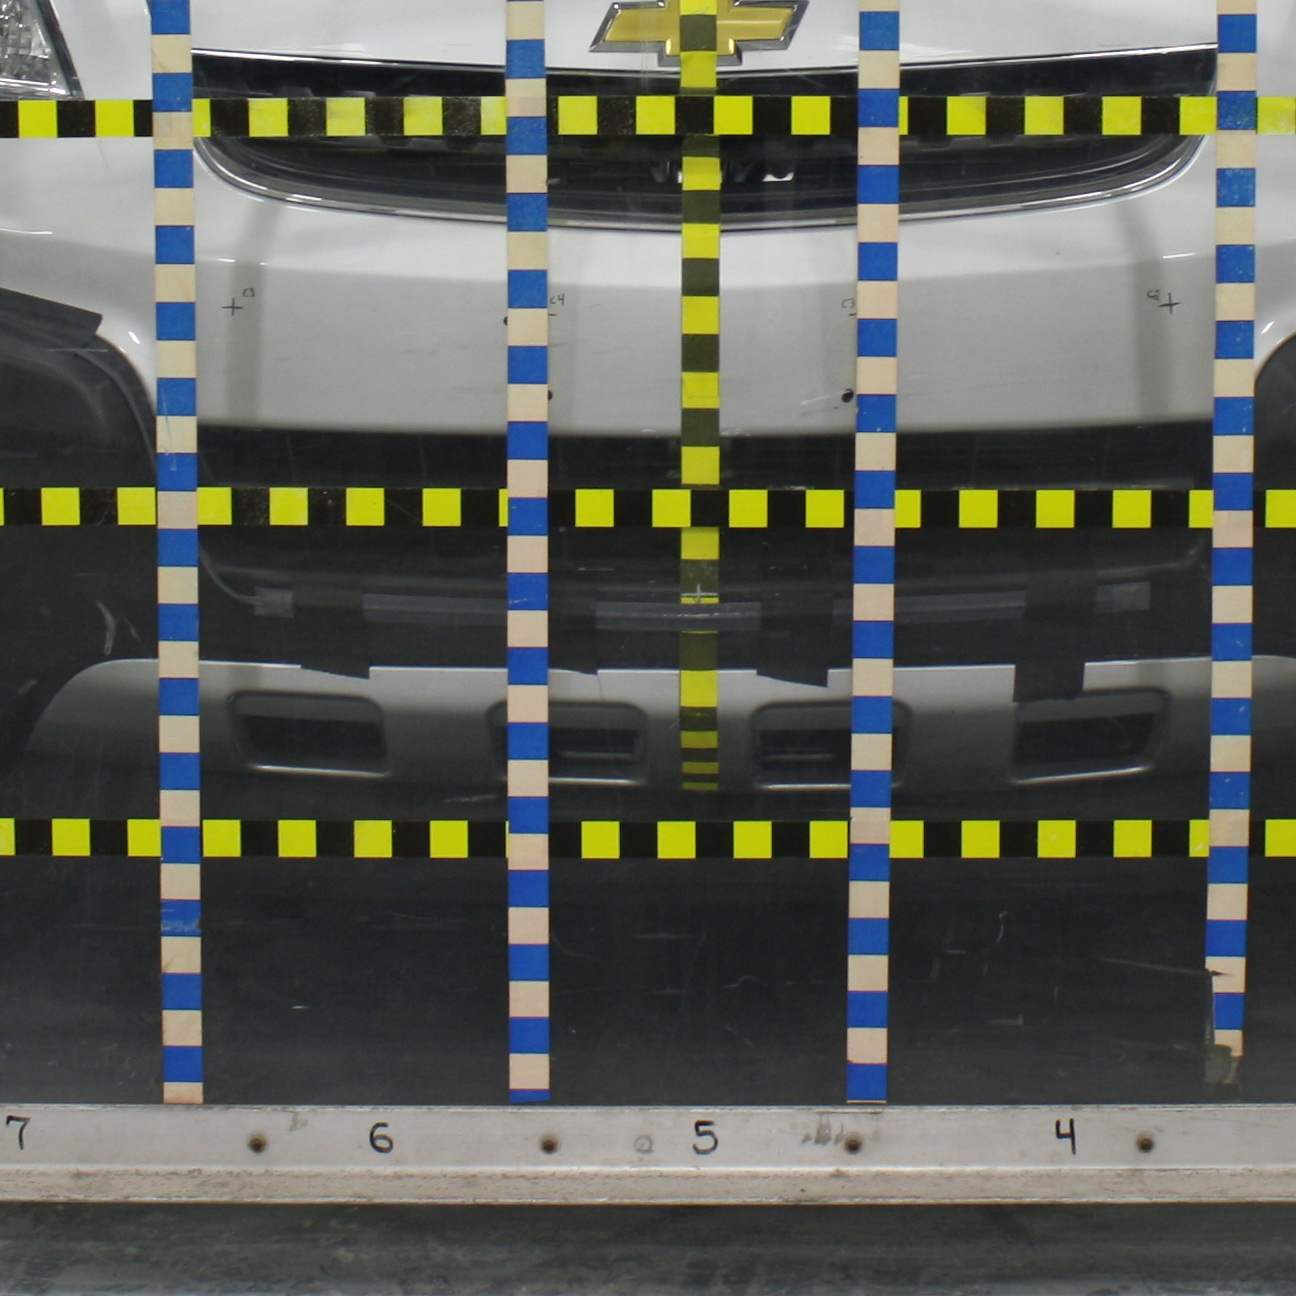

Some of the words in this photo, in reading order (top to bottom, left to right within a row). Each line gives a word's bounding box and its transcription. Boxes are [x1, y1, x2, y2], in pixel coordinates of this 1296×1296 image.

[5, 1115, 31, 1151] 7
[368, 1121, 395, 1154] 6
[692, 1120, 719, 1155] 5
[1054, 1118, 1077, 1155] 4
